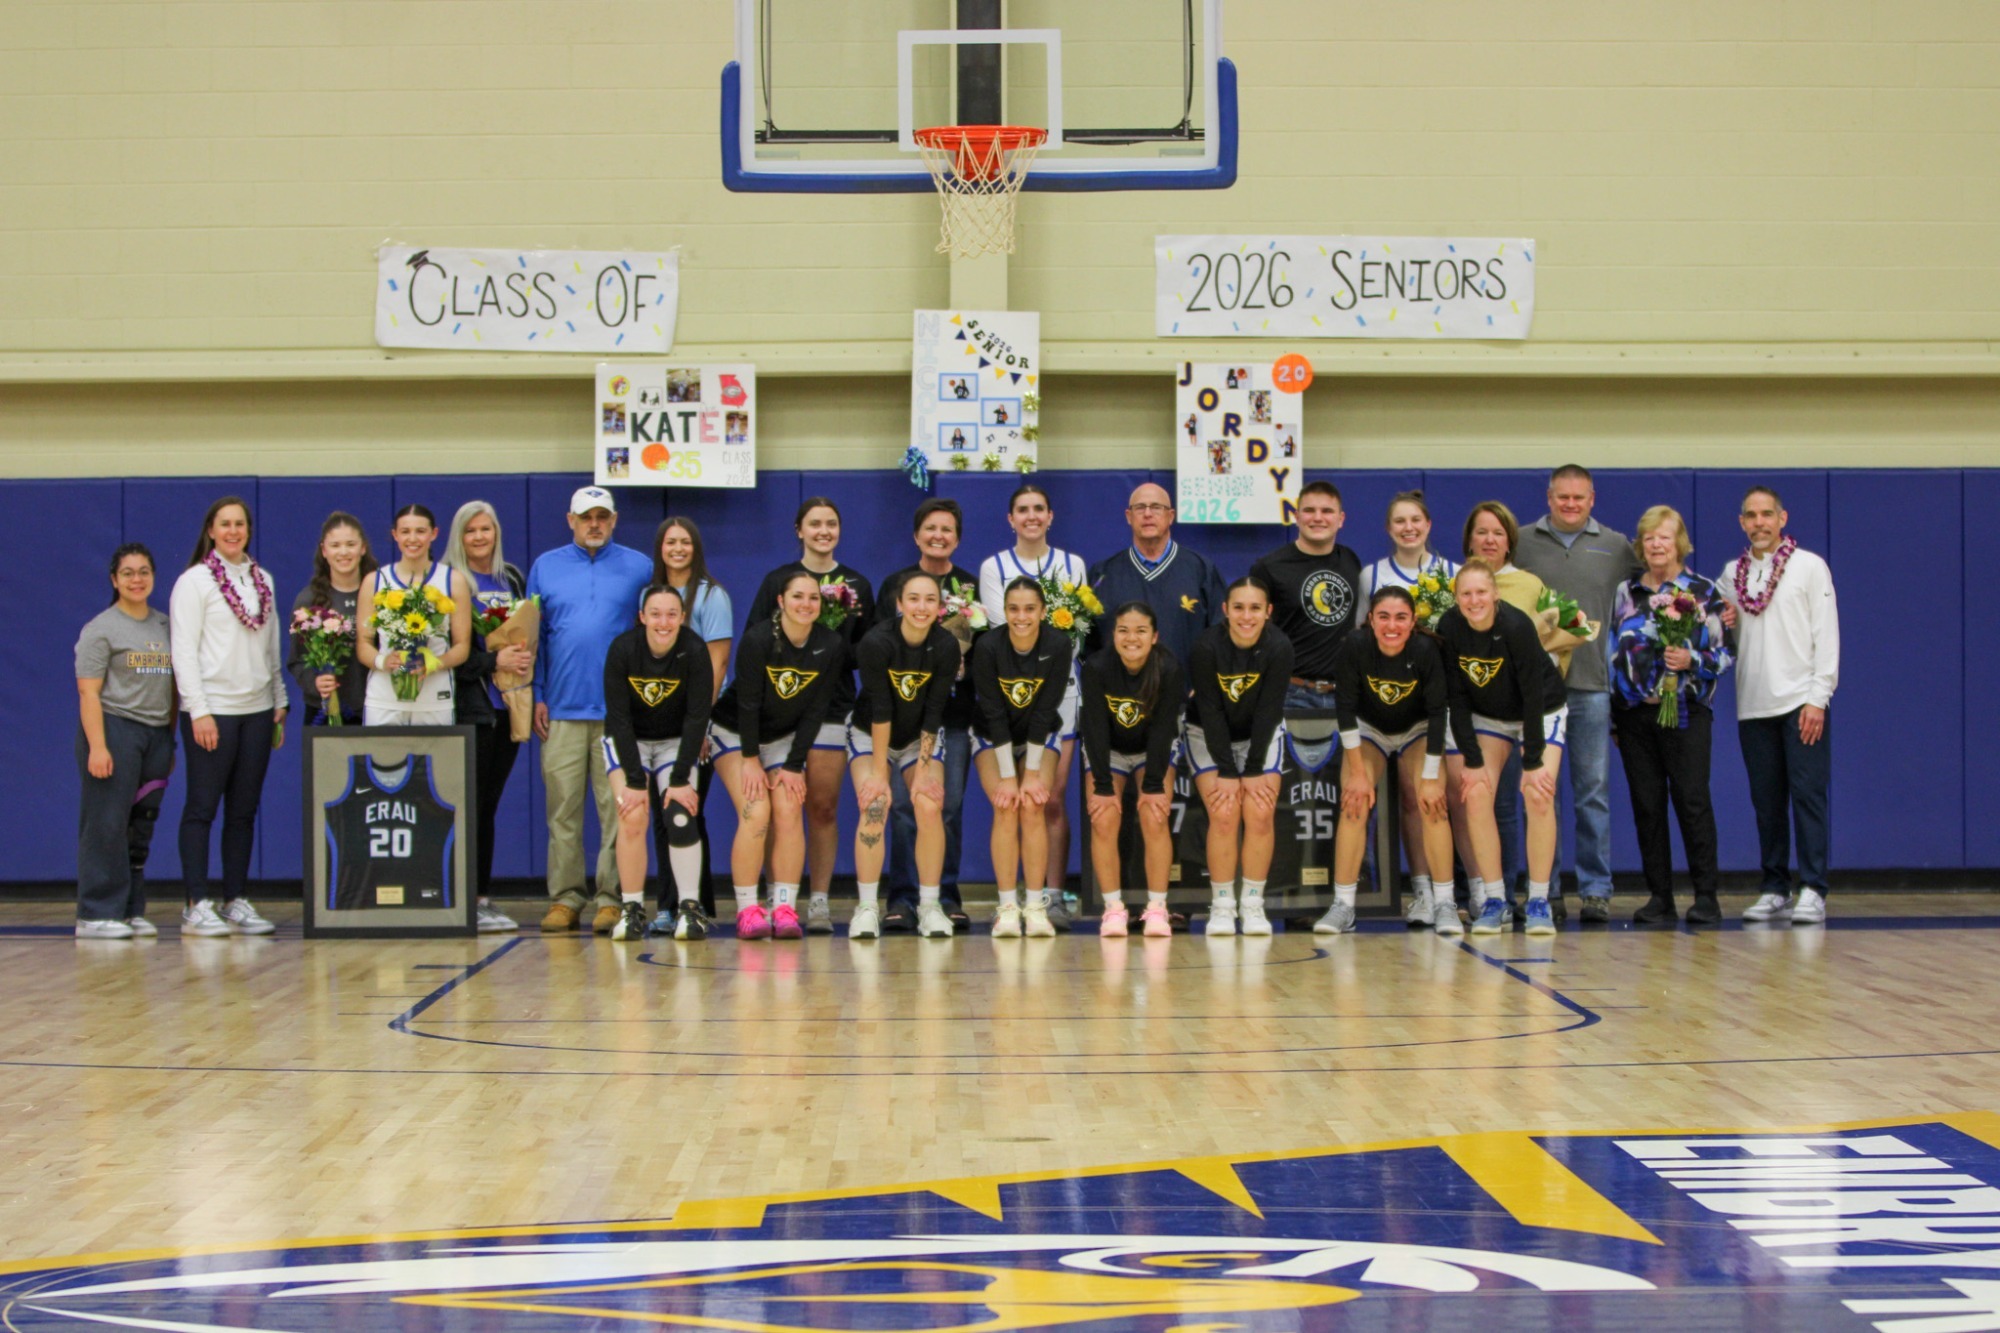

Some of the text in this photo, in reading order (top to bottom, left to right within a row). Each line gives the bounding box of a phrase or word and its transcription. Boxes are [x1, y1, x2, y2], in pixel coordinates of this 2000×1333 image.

[1186, 250, 1507, 312] 2026 SENIORS
[408, 262, 657, 327] CLASS OF
[966, 319, 1030, 370] SENIOR
[988, 332, 1012, 353] 2026
[1277, 365, 1306, 382] 20
[630, 411, 720, 443] KATE
[985, 433, 996, 444] 27
[1007, 430, 1019, 440] 27
[722, 451, 752, 465] CLASS
[997, 446, 1008, 454] 27
[1180, 498, 1241, 522] 2026
[1307, 601, 1350, 623] BASKETBALL
[1290, 781, 1337, 805] ERAU
[365, 801, 417, 824] ERAU
[1295, 809, 1334, 840] 35
[370, 828, 412, 858] 20
